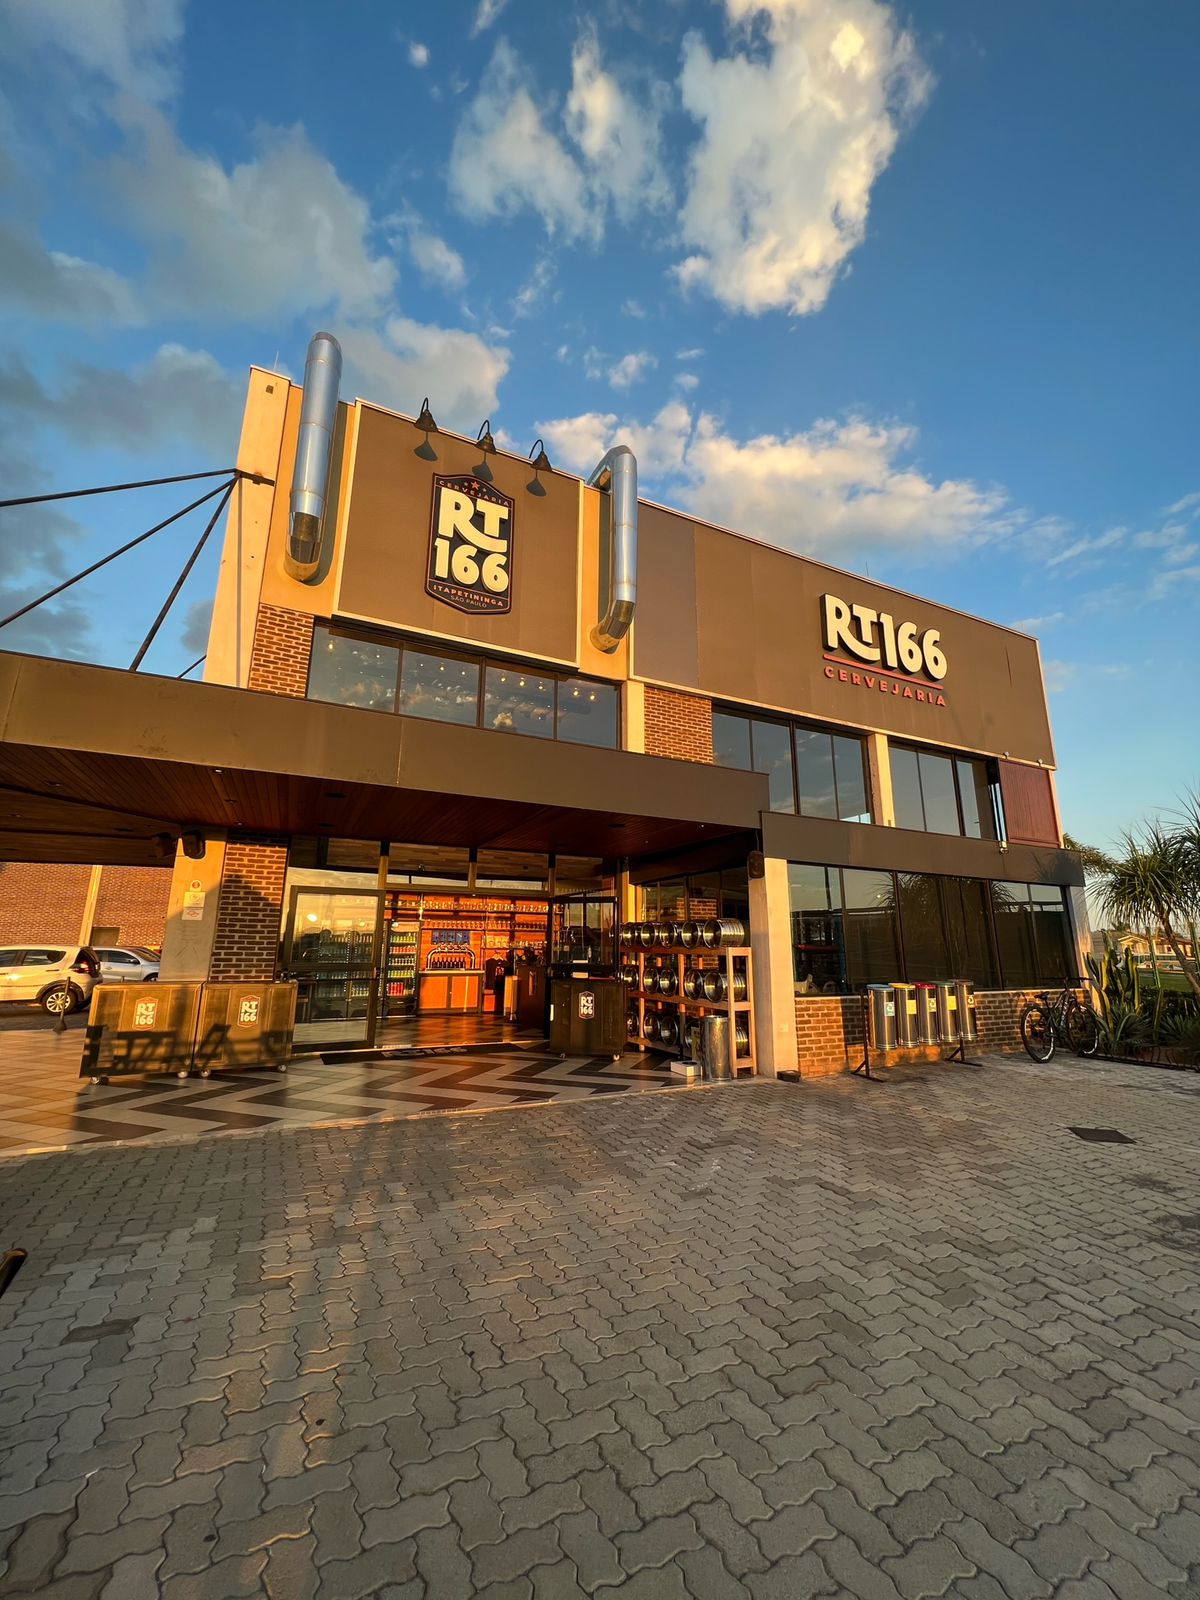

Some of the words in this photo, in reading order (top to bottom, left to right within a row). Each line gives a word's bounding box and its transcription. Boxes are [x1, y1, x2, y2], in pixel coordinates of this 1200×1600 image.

[439, 480, 509, 506] CERVEJARIA
[438, 487, 509, 553] RT
[434, 538, 509, 593] 166
[433, 584, 503, 607] ITAPETININGA
[466, 598, 487, 608] PAULO
[824, 666, 946, 707] CERVEJARIA
[241, 1001, 258, 1013] RT
[580, 996, 593, 1007] RT
[137, 1003, 155, 1015] RT
[580, 1006, 593, 1014] 166
[135, 1015, 153, 1025] 166
[240, 1012, 257, 1022] 166
